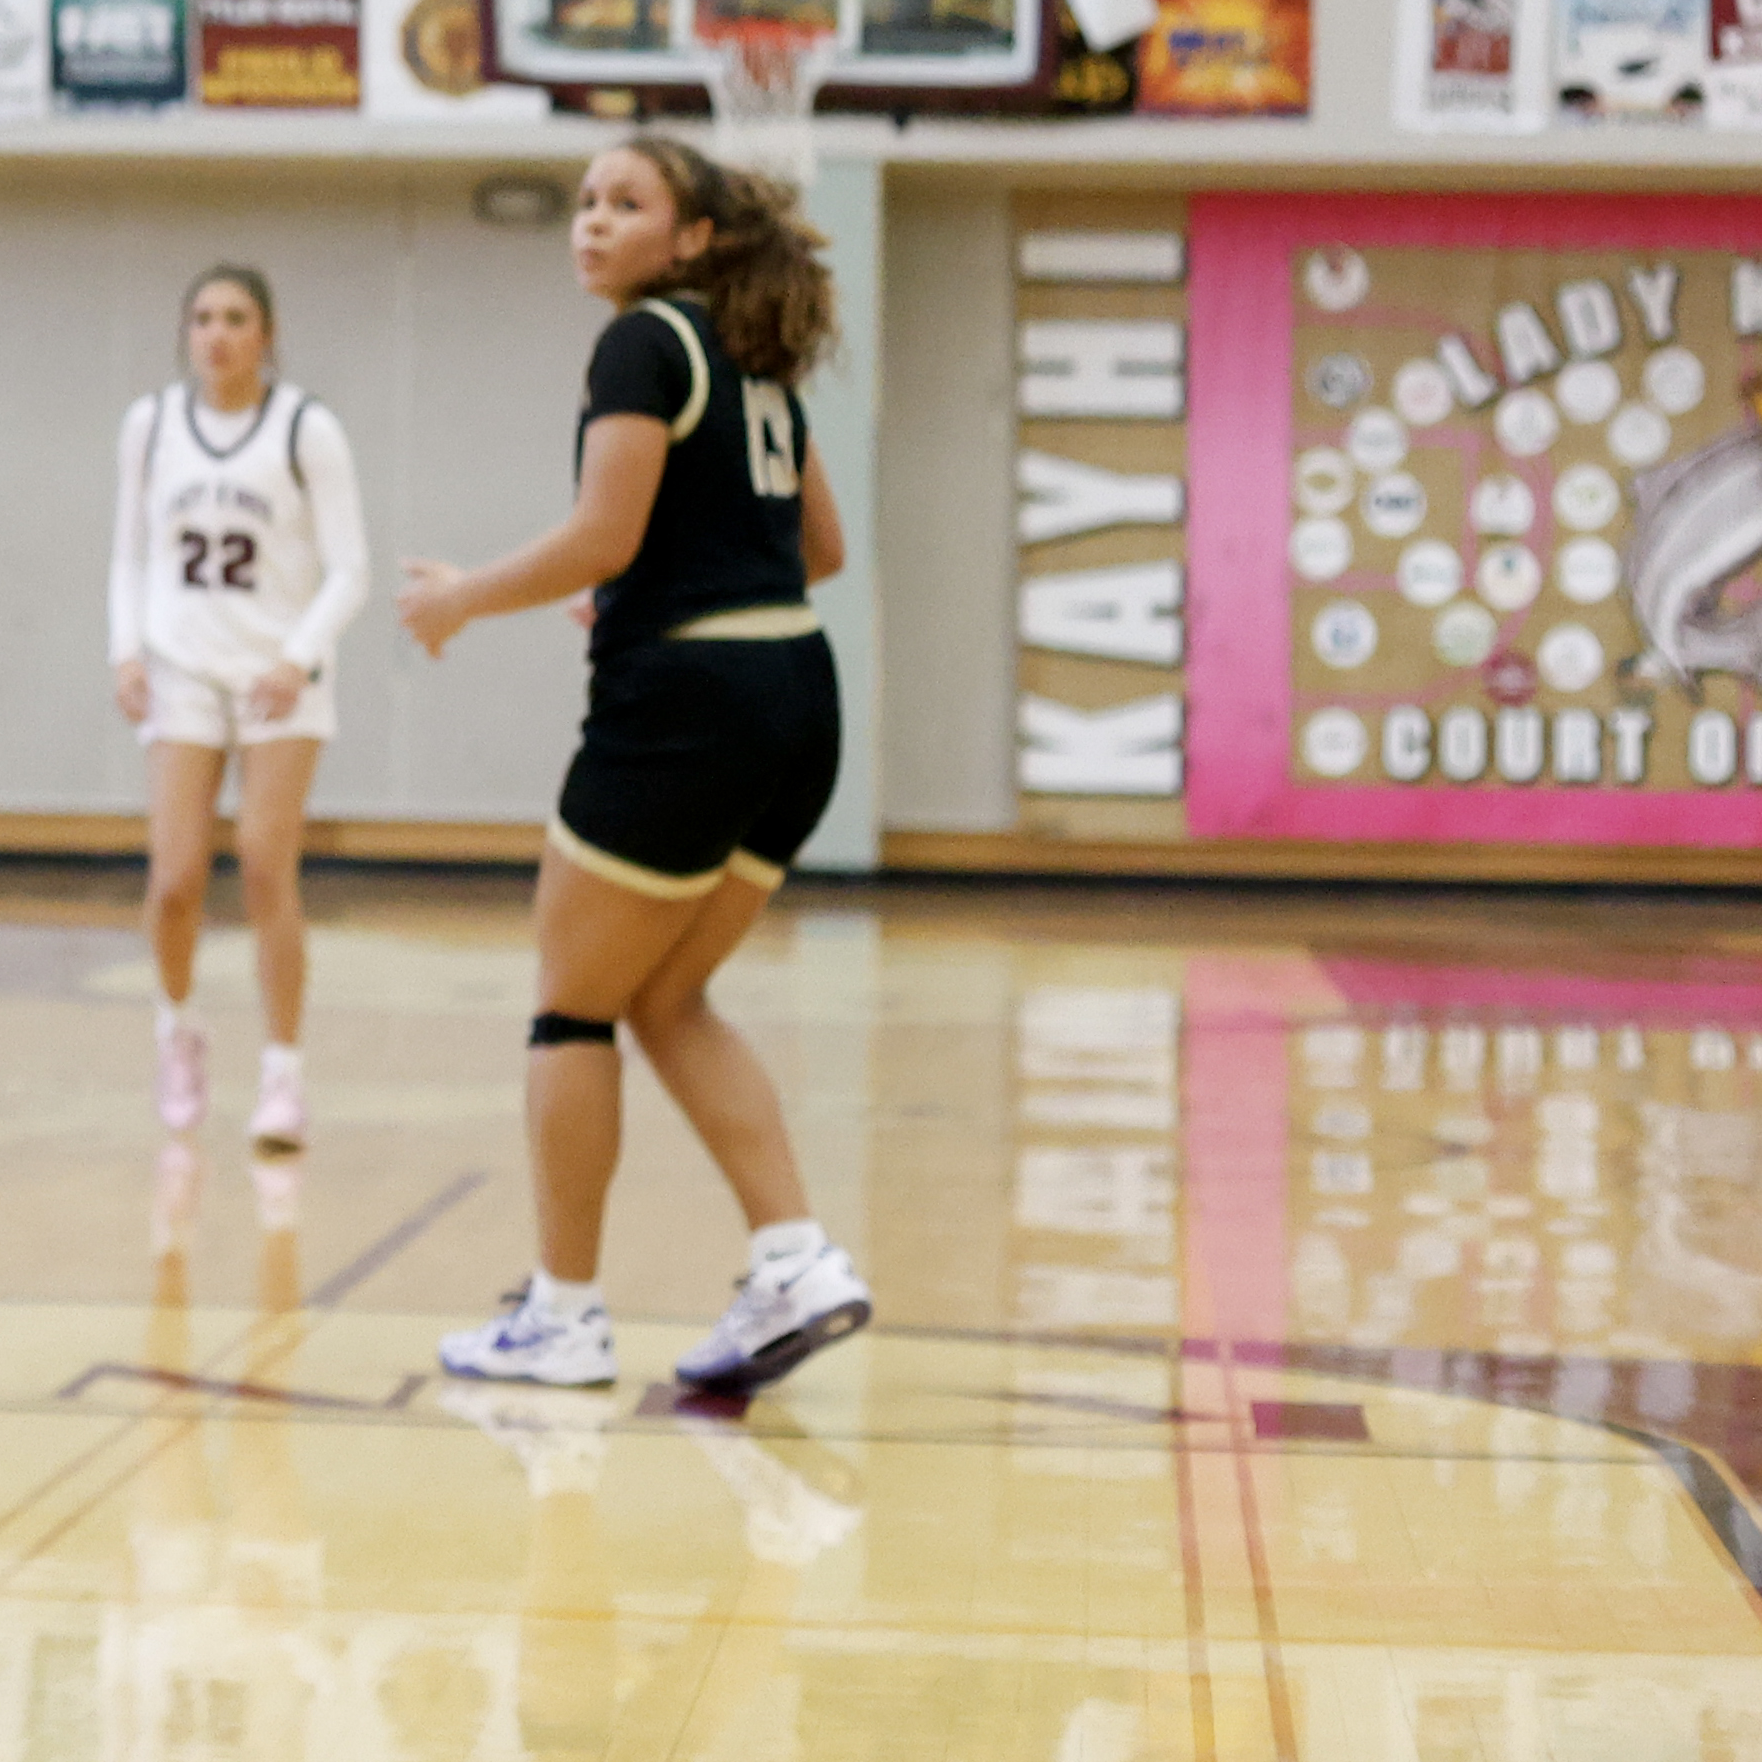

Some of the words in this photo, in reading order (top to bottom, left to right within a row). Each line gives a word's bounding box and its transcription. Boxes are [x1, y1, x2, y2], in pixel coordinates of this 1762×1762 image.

[1435, 262, 1679, 410] LADY
[180, 530, 257, 591] 22
[1017, 231, 1186, 797] KAYHI
[1381, 705, 1652, 786] COURT
